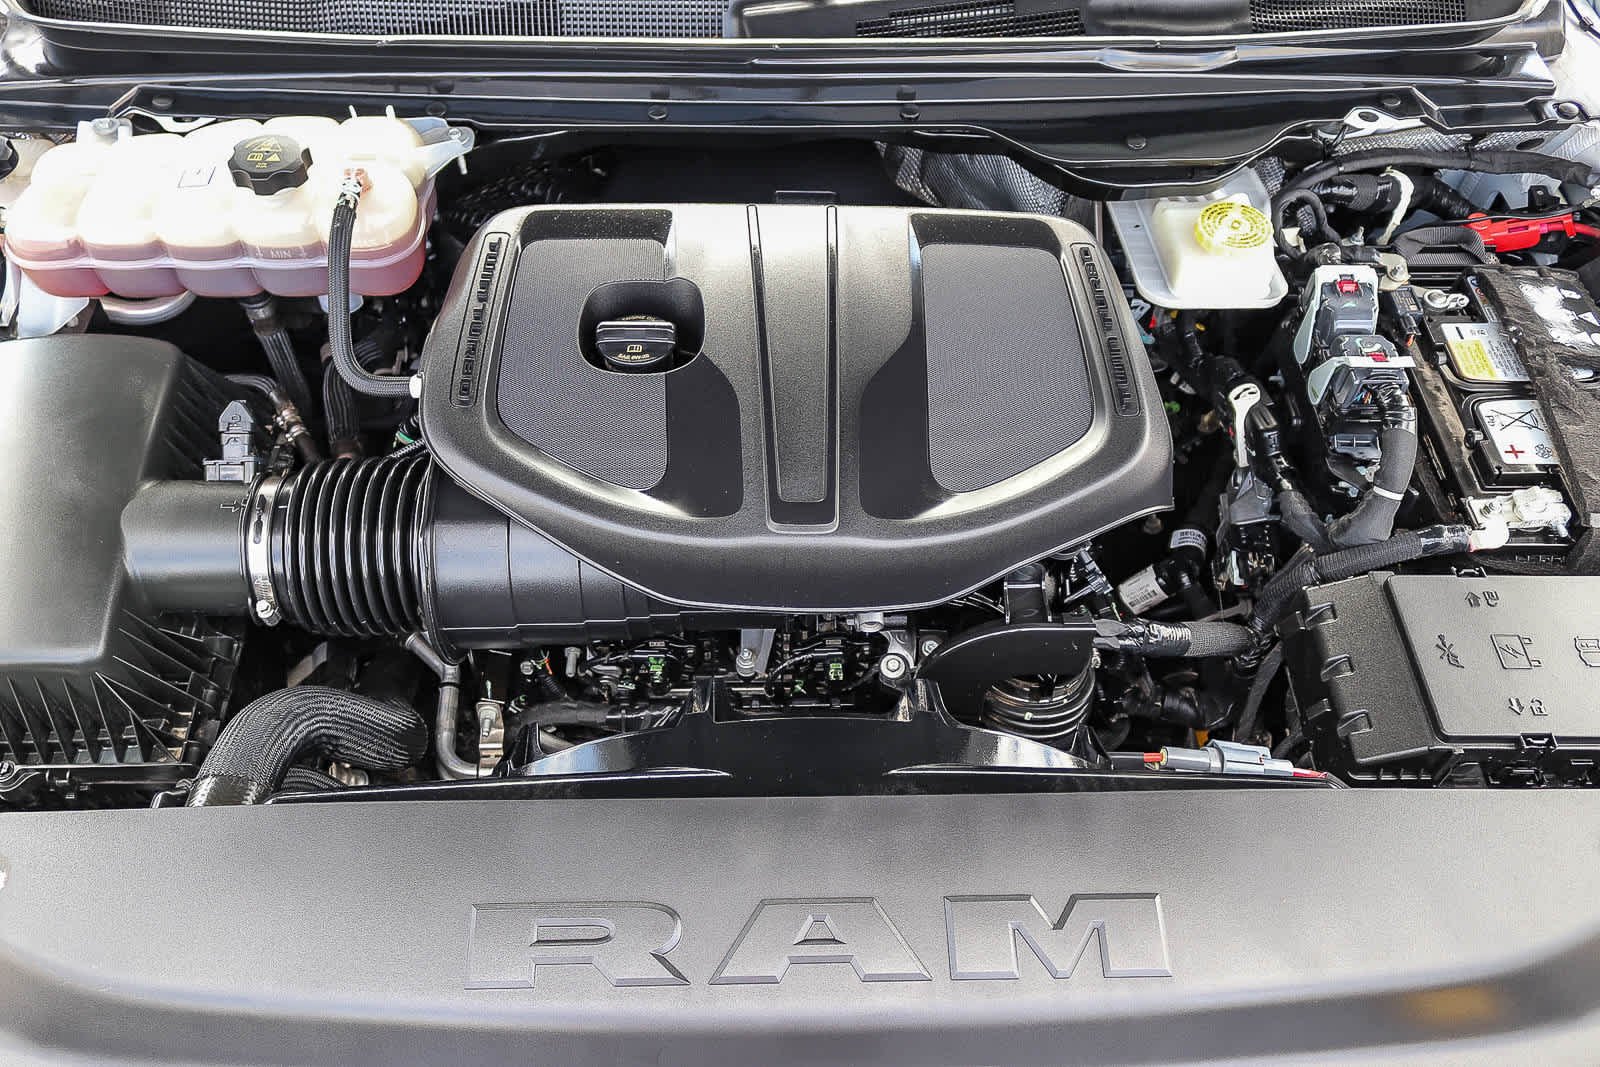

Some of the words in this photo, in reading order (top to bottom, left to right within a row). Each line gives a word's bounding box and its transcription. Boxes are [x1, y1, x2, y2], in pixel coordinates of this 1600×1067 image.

[476, 237, 502, 303] TWIN
[1078, 247, 1114, 333] TURBO
[458, 303, 486, 402] TURBO
[464, 893, 1173, 989] RAM
